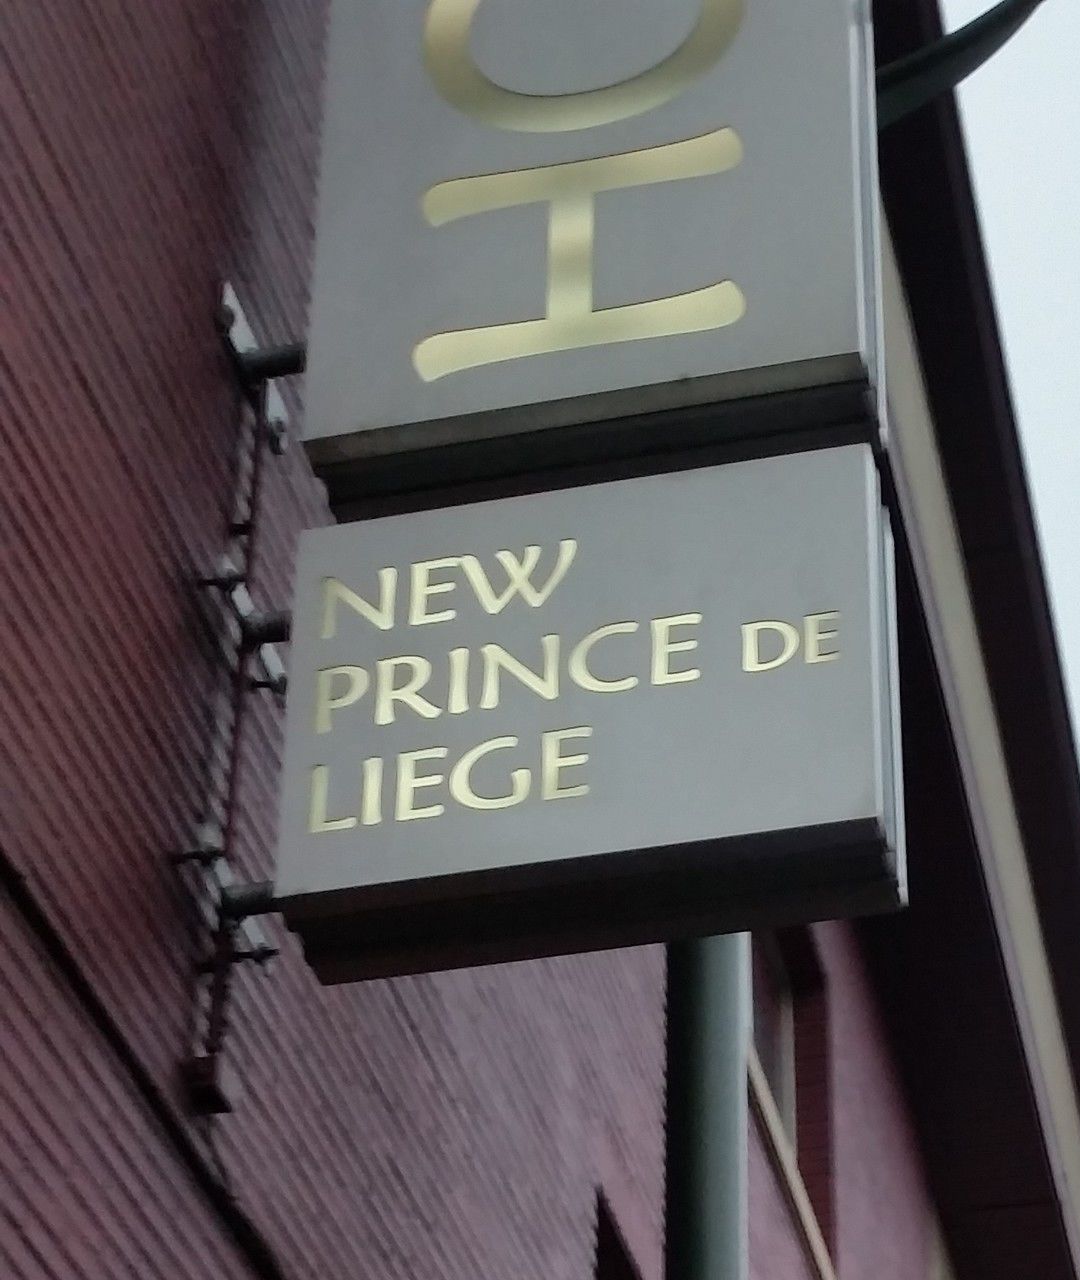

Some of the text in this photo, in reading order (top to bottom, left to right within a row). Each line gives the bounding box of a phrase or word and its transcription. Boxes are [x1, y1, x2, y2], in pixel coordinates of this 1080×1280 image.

[319, 538, 578, 640] NEW
[315, 610, 845, 735] PRINCE DE
[308, 725, 594, 834] LIEGE
